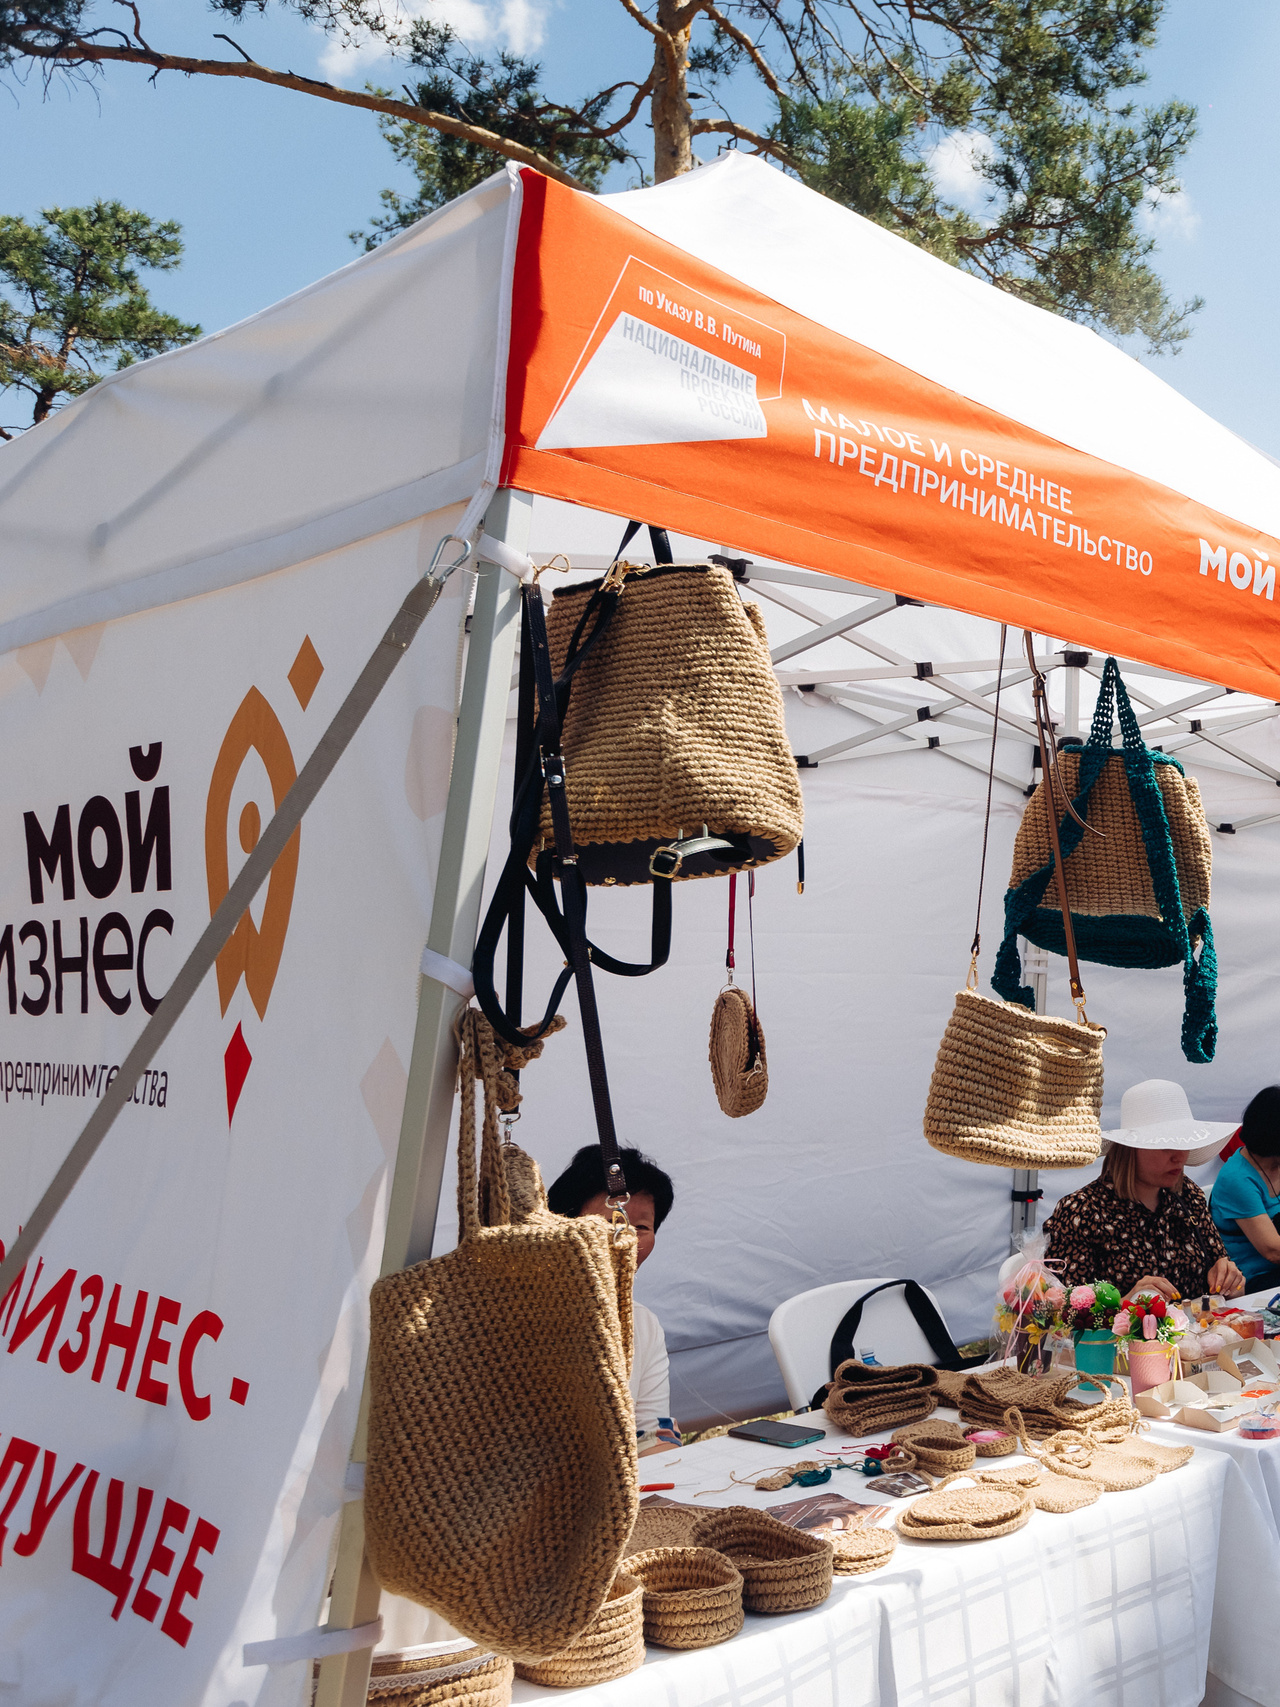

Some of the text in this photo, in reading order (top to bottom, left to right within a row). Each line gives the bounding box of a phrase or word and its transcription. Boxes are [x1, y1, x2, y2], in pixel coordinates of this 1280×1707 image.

[623, 316, 754, 396] НАЦИОНАЛЬНЫЕ
[697, 396, 764, 432] РОССИИ
[802, 398, 1073, 515] МАЛОЕ И СРЕДНЕЕ
[814, 428, 1153, 576] ПРЕДПРИНИМАТЕЛЬСТВО
